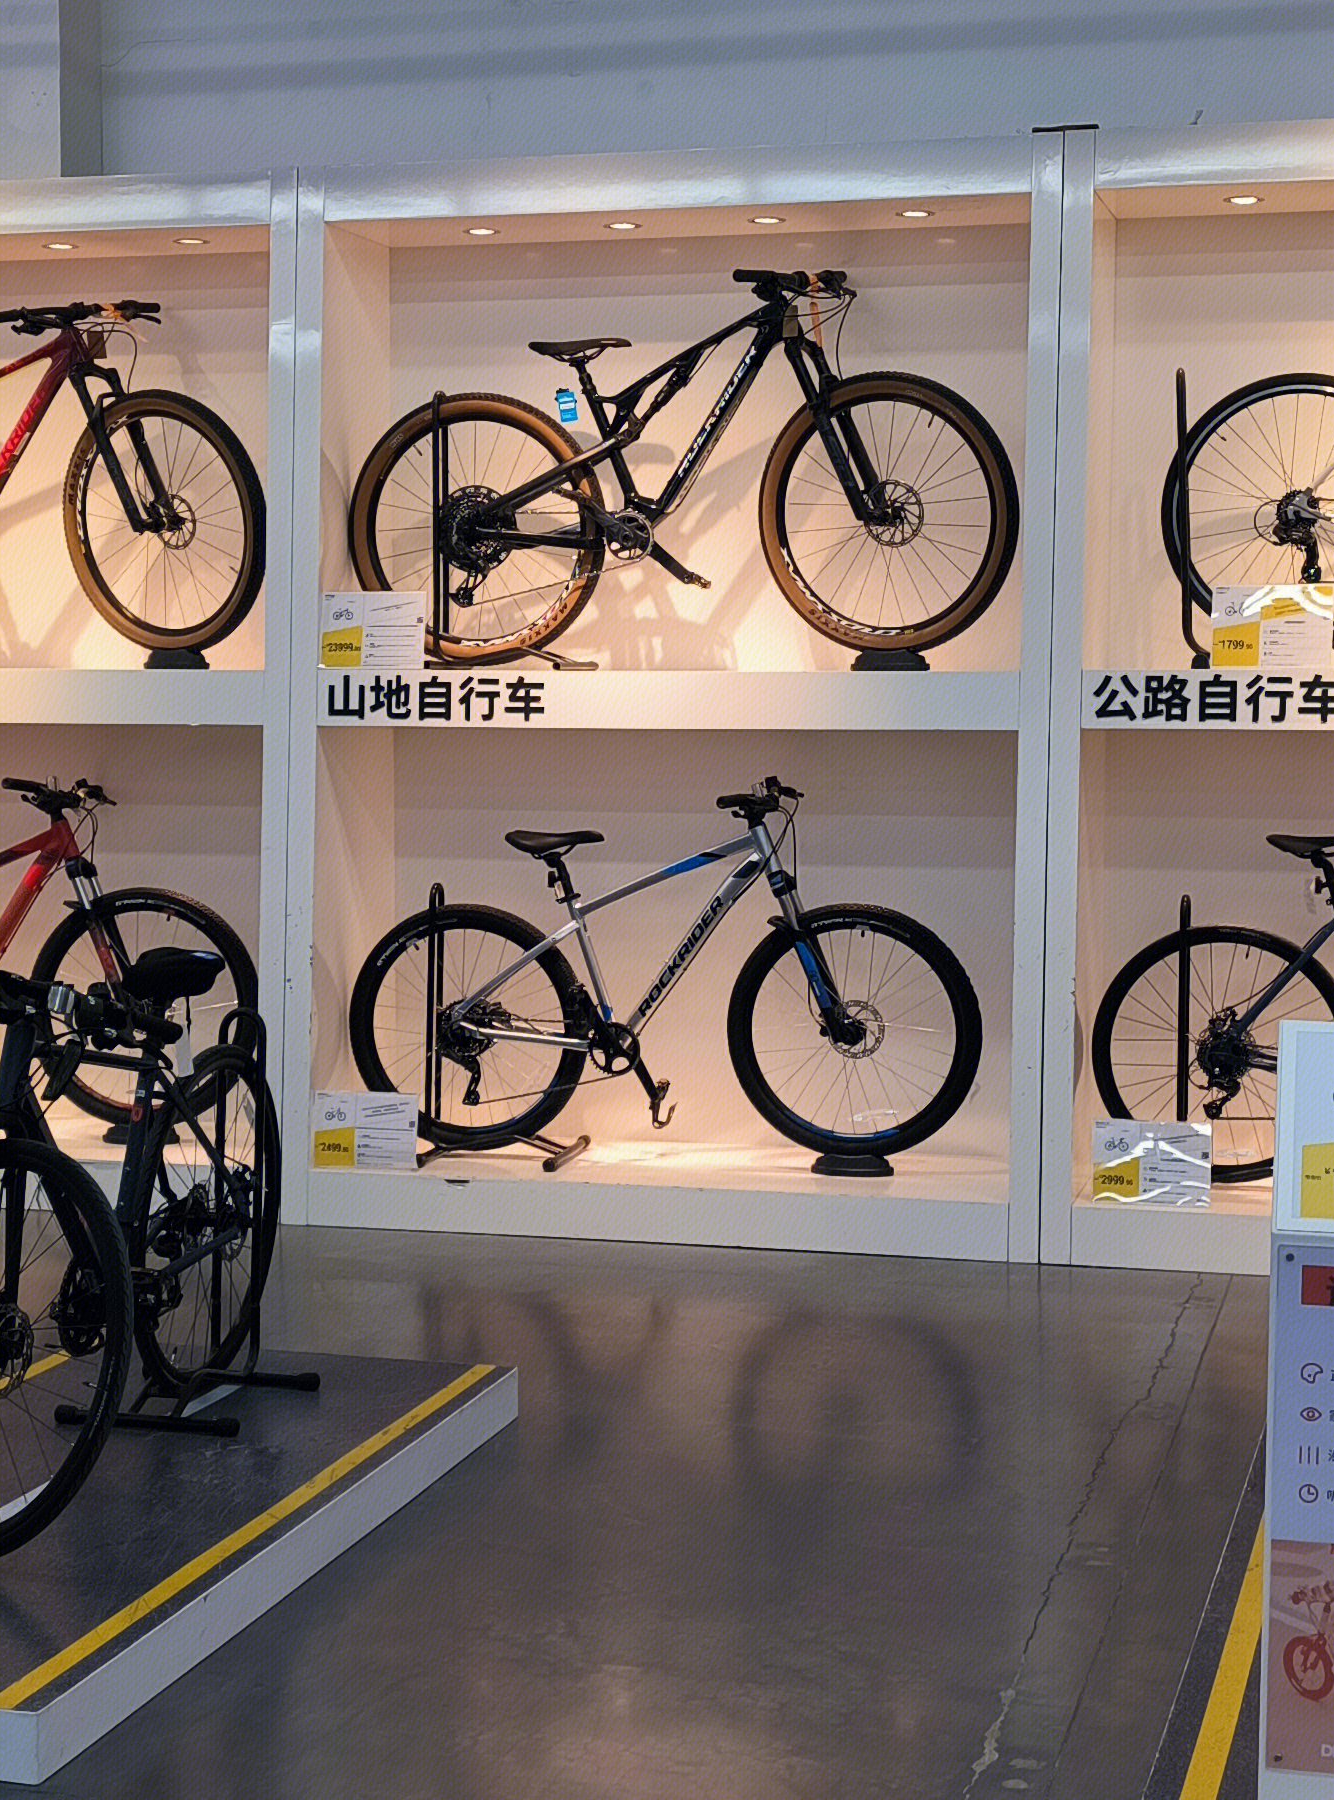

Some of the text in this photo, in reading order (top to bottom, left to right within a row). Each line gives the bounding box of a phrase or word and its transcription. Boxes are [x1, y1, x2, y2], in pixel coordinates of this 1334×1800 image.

[328, 674, 545, 722] 山地自行车
[637, 895, 724, 1018] ROCKRIDER
